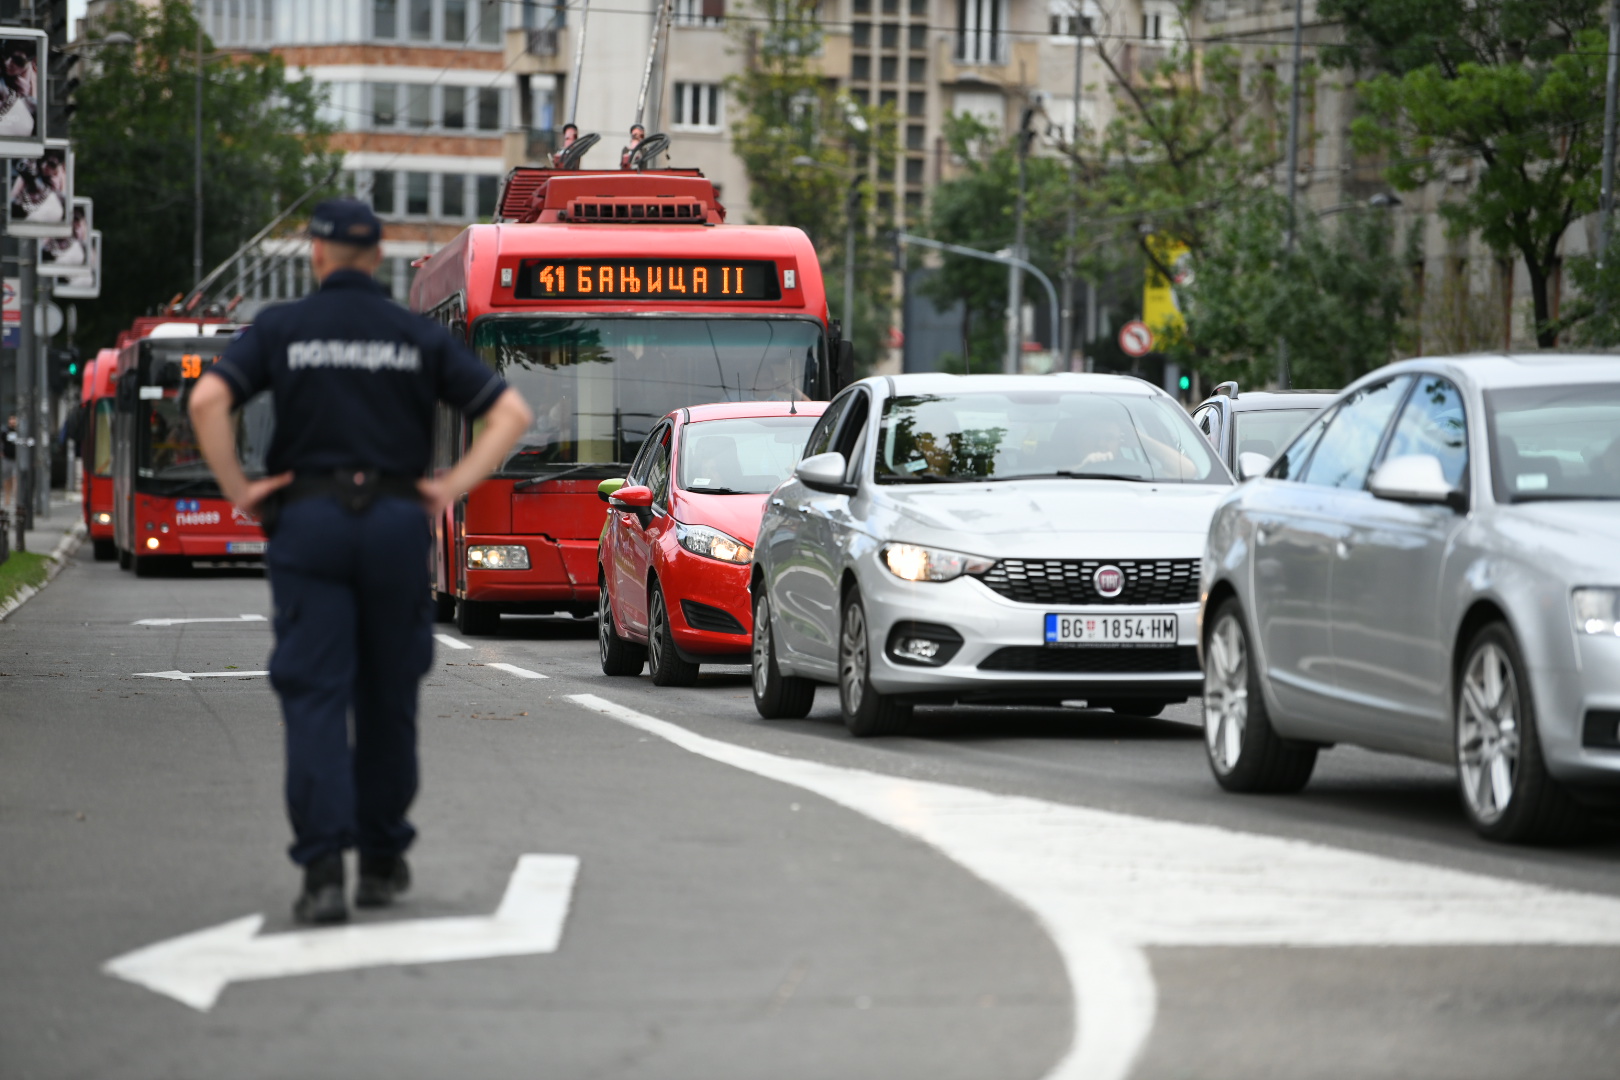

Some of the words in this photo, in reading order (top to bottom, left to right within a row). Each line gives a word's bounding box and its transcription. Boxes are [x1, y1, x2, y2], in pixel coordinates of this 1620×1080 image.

[539, 265, 565, 292] 41
[577, 265, 708, 293] БАЊИЦА
[721, 267, 744, 294] II
[181, 353, 202, 379] 58
[1100, 574, 1119, 590] FIAT
[1061, 618, 1083, 639] BG
